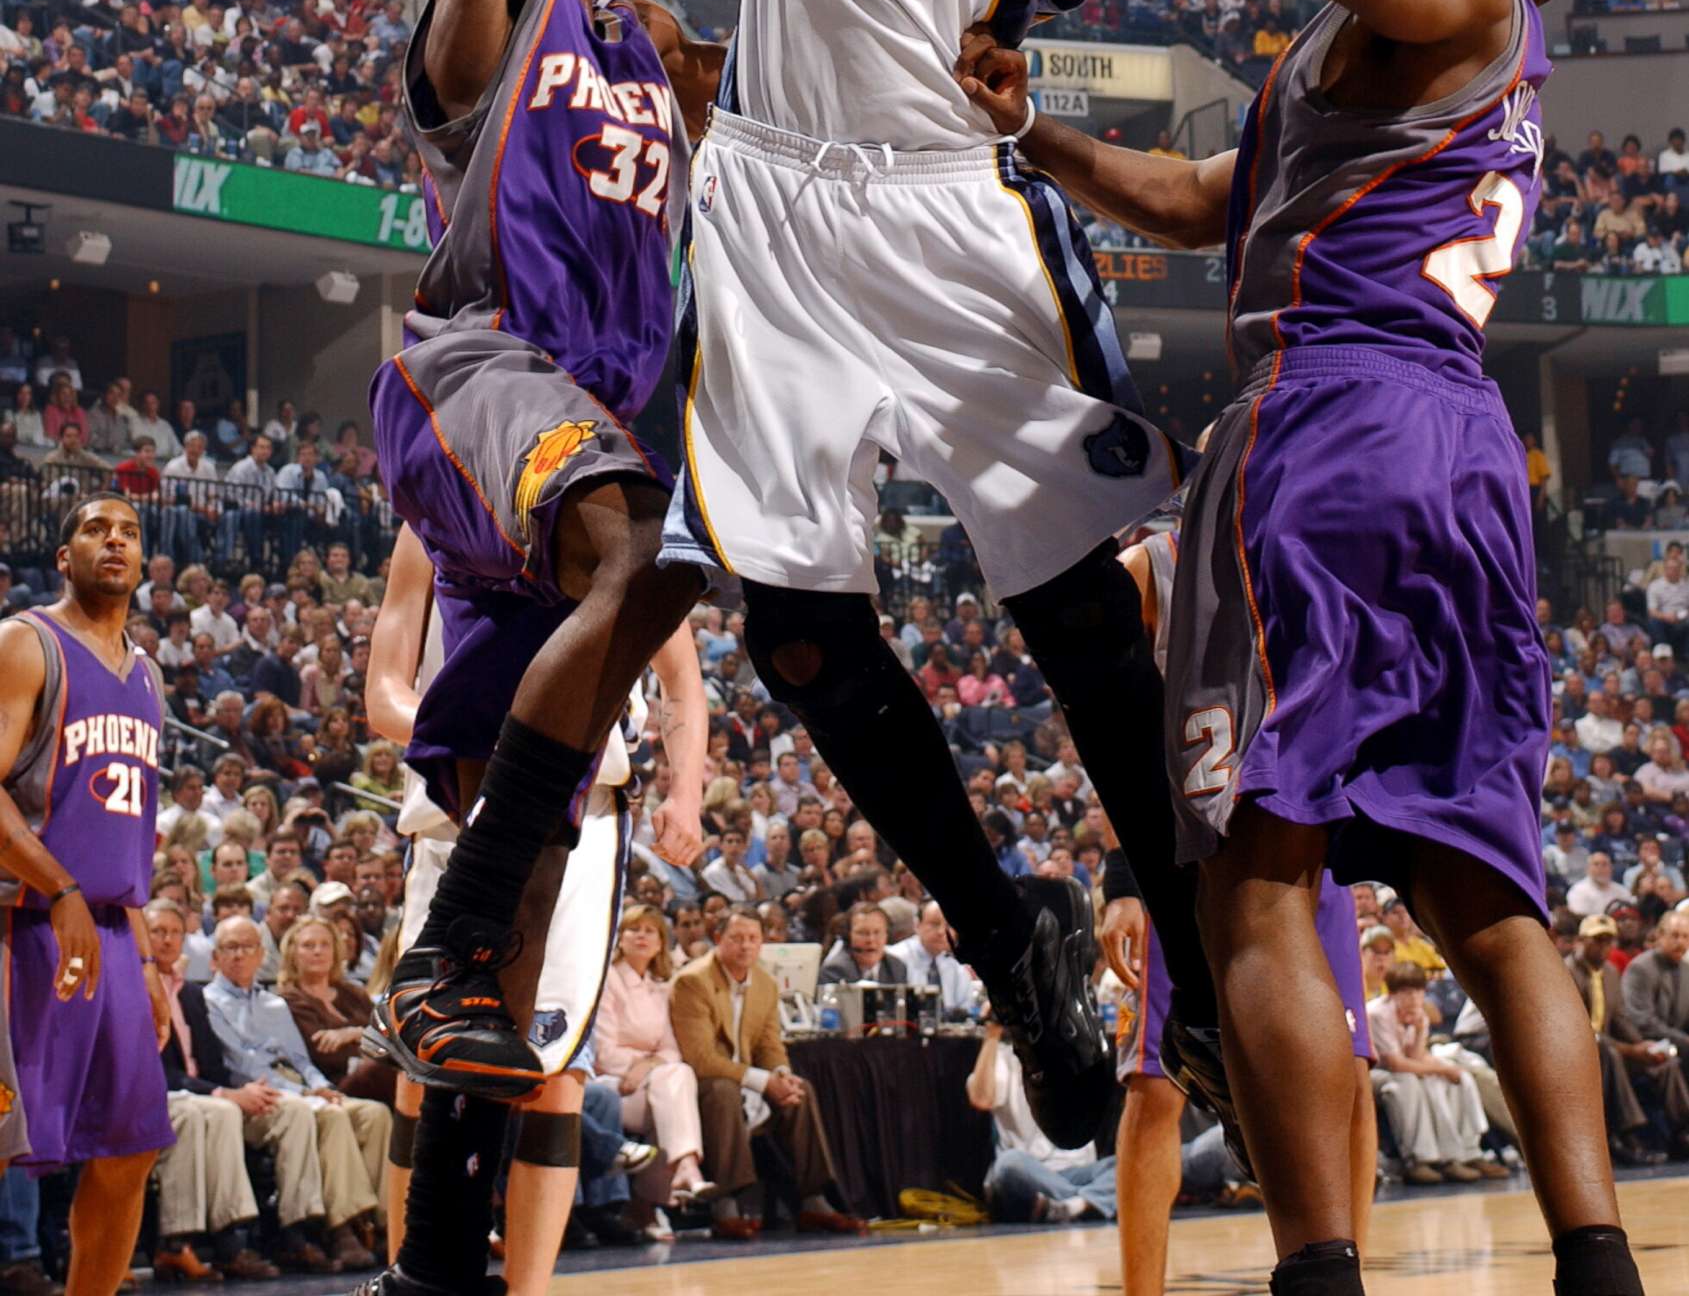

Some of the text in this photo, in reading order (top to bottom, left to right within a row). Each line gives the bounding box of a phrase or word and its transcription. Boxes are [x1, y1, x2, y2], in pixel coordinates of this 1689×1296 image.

[1049, 52, 1113, 80] SOUTH
[1043, 94, 1086, 112] 112A
[588, 122, 671, 217] 32
[1419, 169, 1525, 332] 2
[1541, 296, 1557, 321] 3
[1183, 705, 1236, 799] 2
[104, 762, 143, 817] 21
